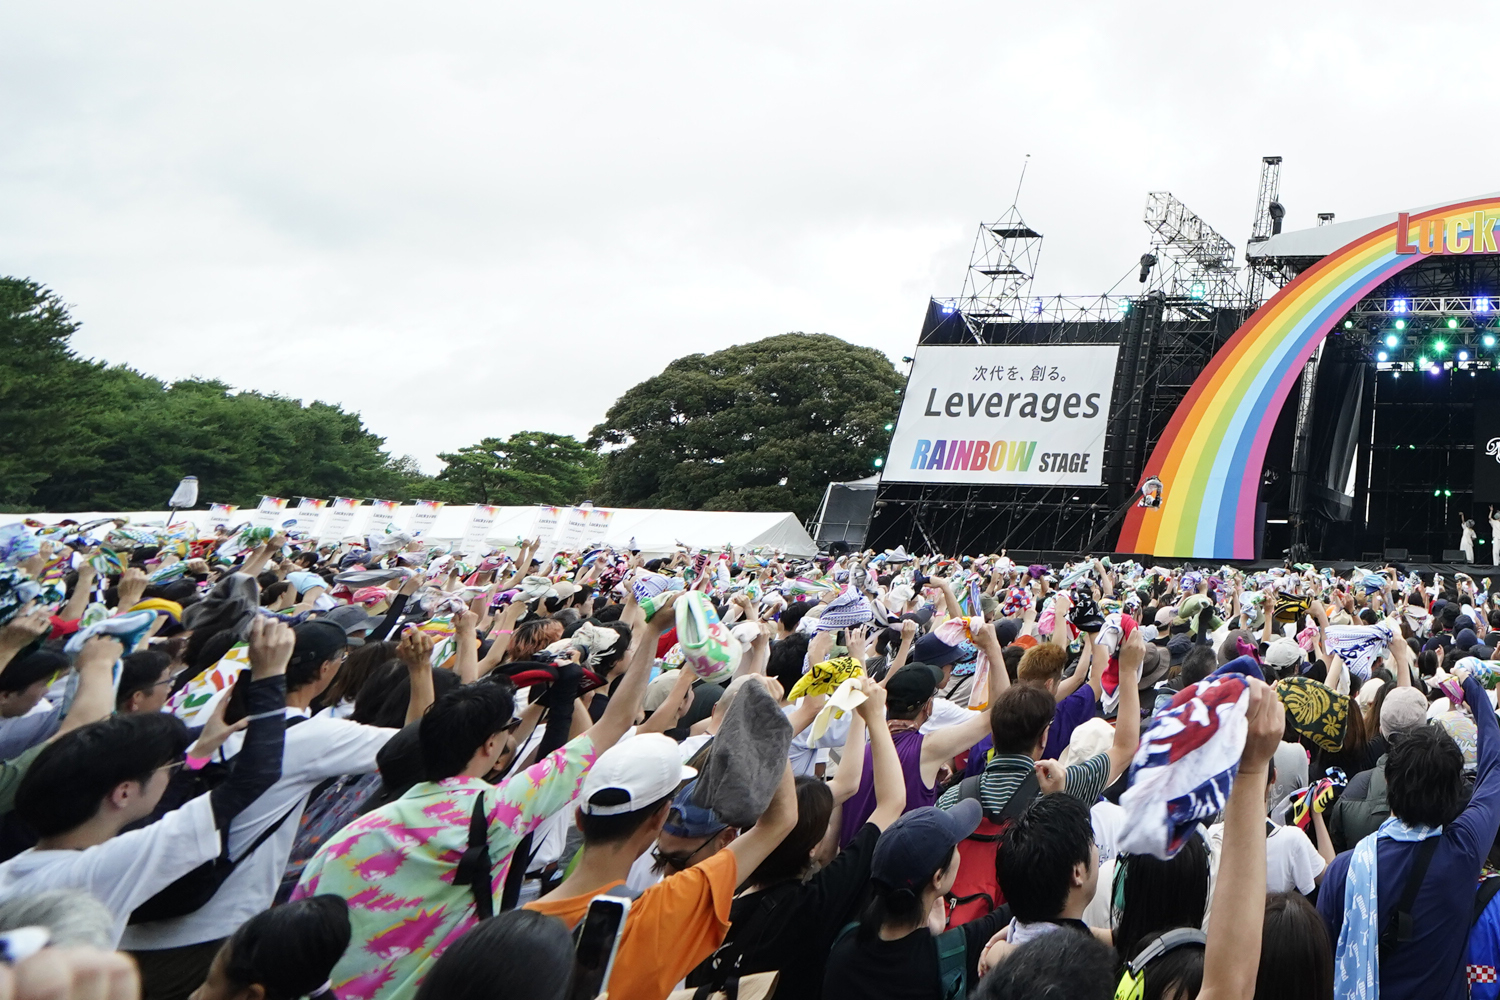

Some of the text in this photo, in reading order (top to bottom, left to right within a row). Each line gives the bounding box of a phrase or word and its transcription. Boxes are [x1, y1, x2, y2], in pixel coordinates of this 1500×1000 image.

[972, 365, 1067, 382] 次代を、創る。
[924, 388, 1101, 423] Leverages
[910, 439, 1091, 473] RAINBOW STAGE
